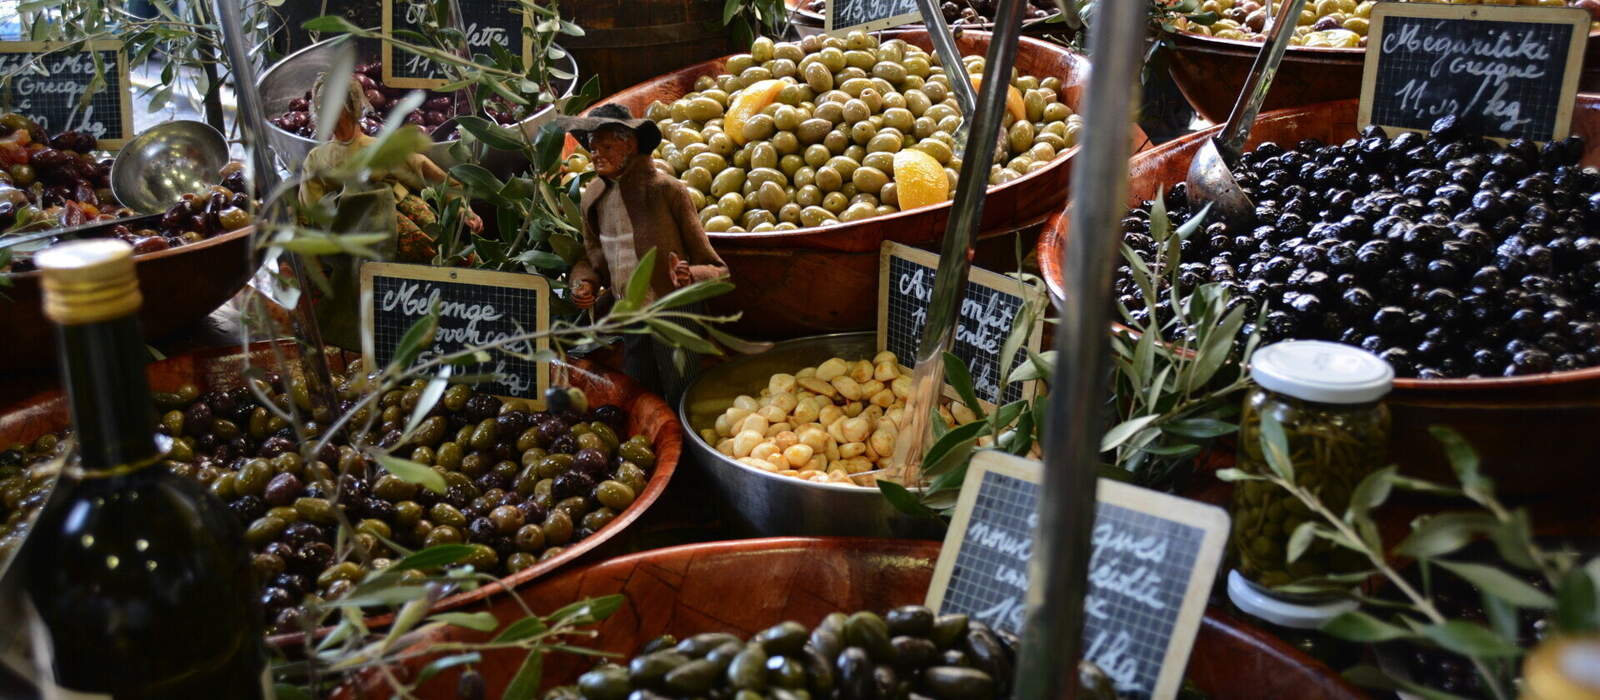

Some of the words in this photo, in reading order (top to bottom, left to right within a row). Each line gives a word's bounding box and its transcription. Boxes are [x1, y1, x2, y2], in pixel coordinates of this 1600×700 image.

[17, 77, 107, 108] Grecq
[382, 281, 503, 323] Mélange
[899, 268, 936, 303] Ai
[960, 293, 1013, 336] onfit
[969, 522, 1032, 561] nouve
